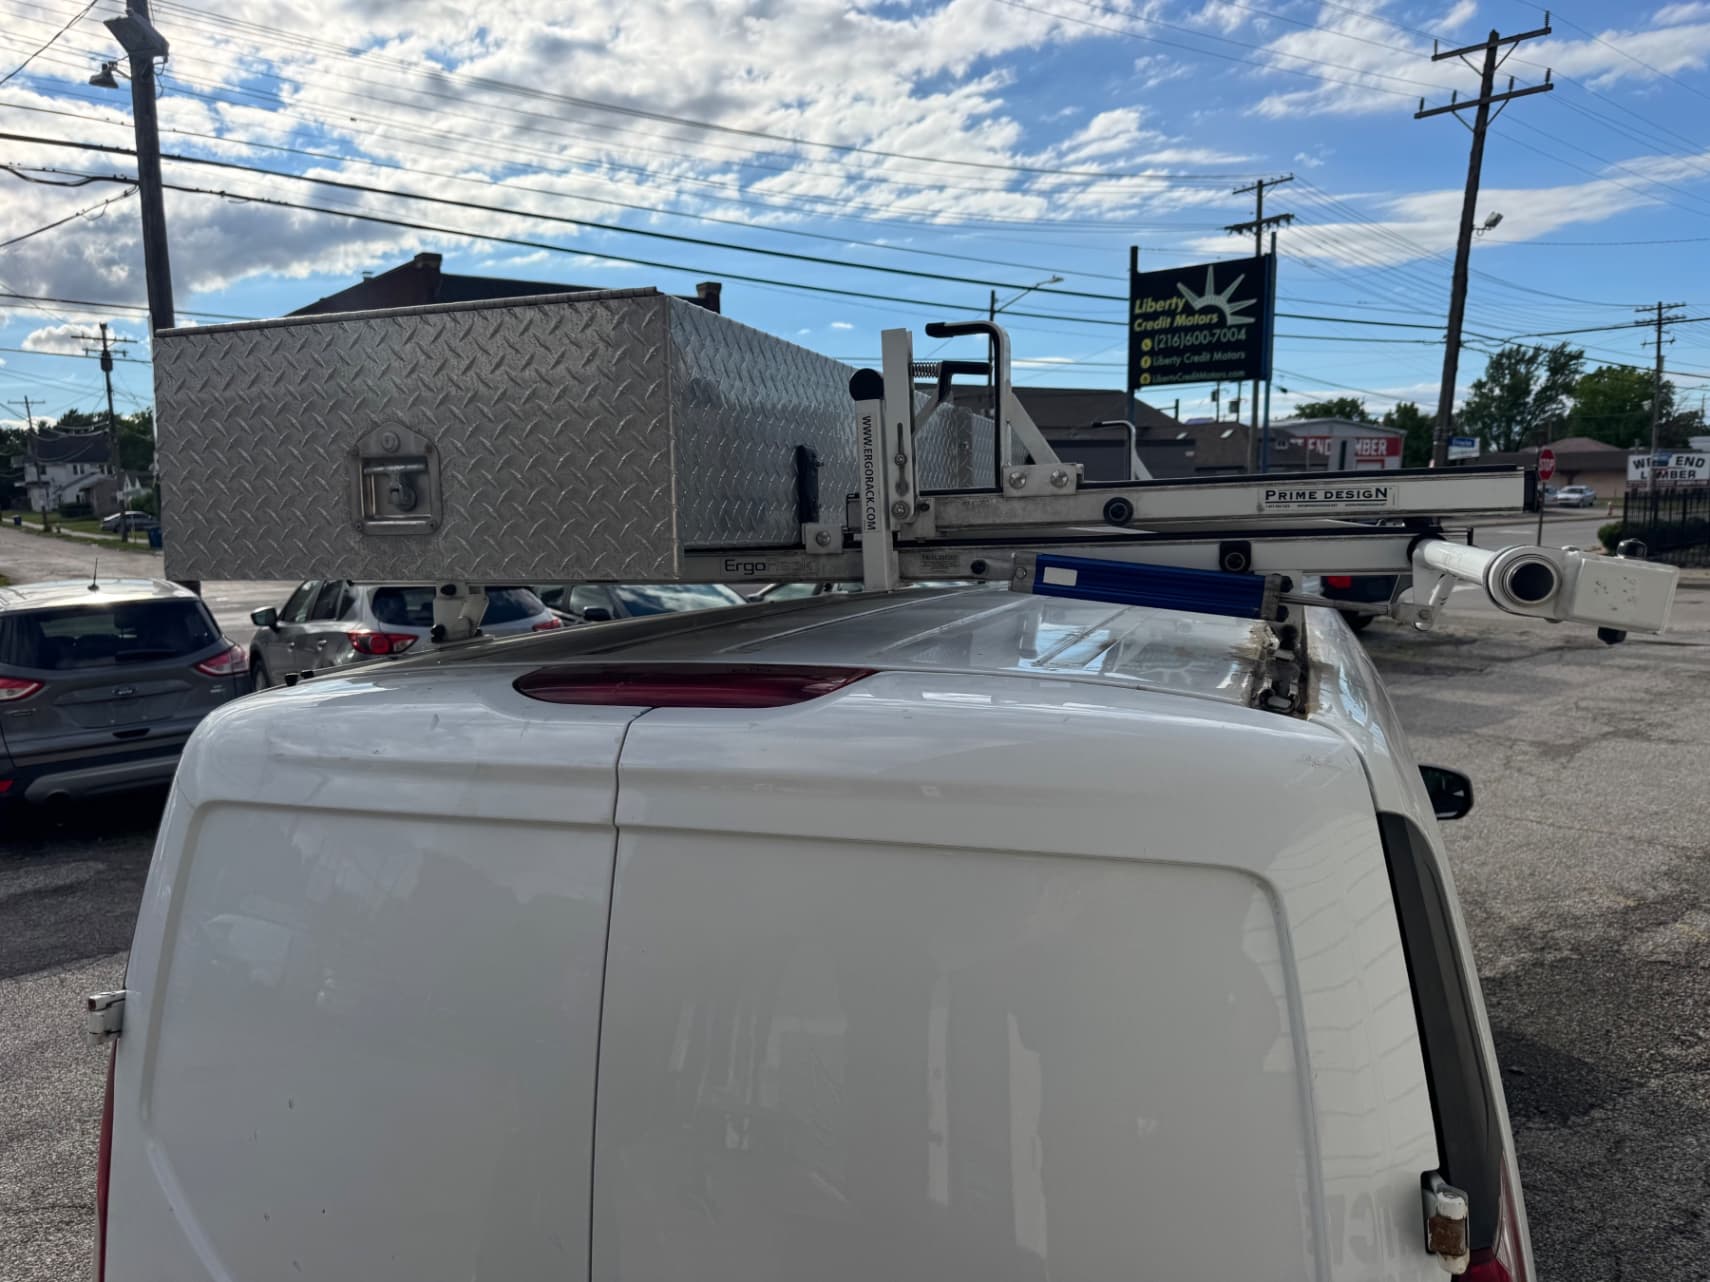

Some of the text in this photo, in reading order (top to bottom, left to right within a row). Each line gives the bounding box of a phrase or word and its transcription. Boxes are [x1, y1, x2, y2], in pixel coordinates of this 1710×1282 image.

[1134, 297, 1186, 314] Liberty
[1134, 313, 1218, 331] Credit Motors
[1154, 327, 1247, 351] (216)600-7004
[1152, 350, 1245, 367] Liberty Credit Motors
[1675, 456, 1705, 468] END
[862, 415, 876, 531] WWW.ERGORACK.COM
[1641, 469, 1696, 480] LMBER
[1265, 487, 1388, 500] PRIME DESIGN
[724, 559, 767, 576] Ergo
